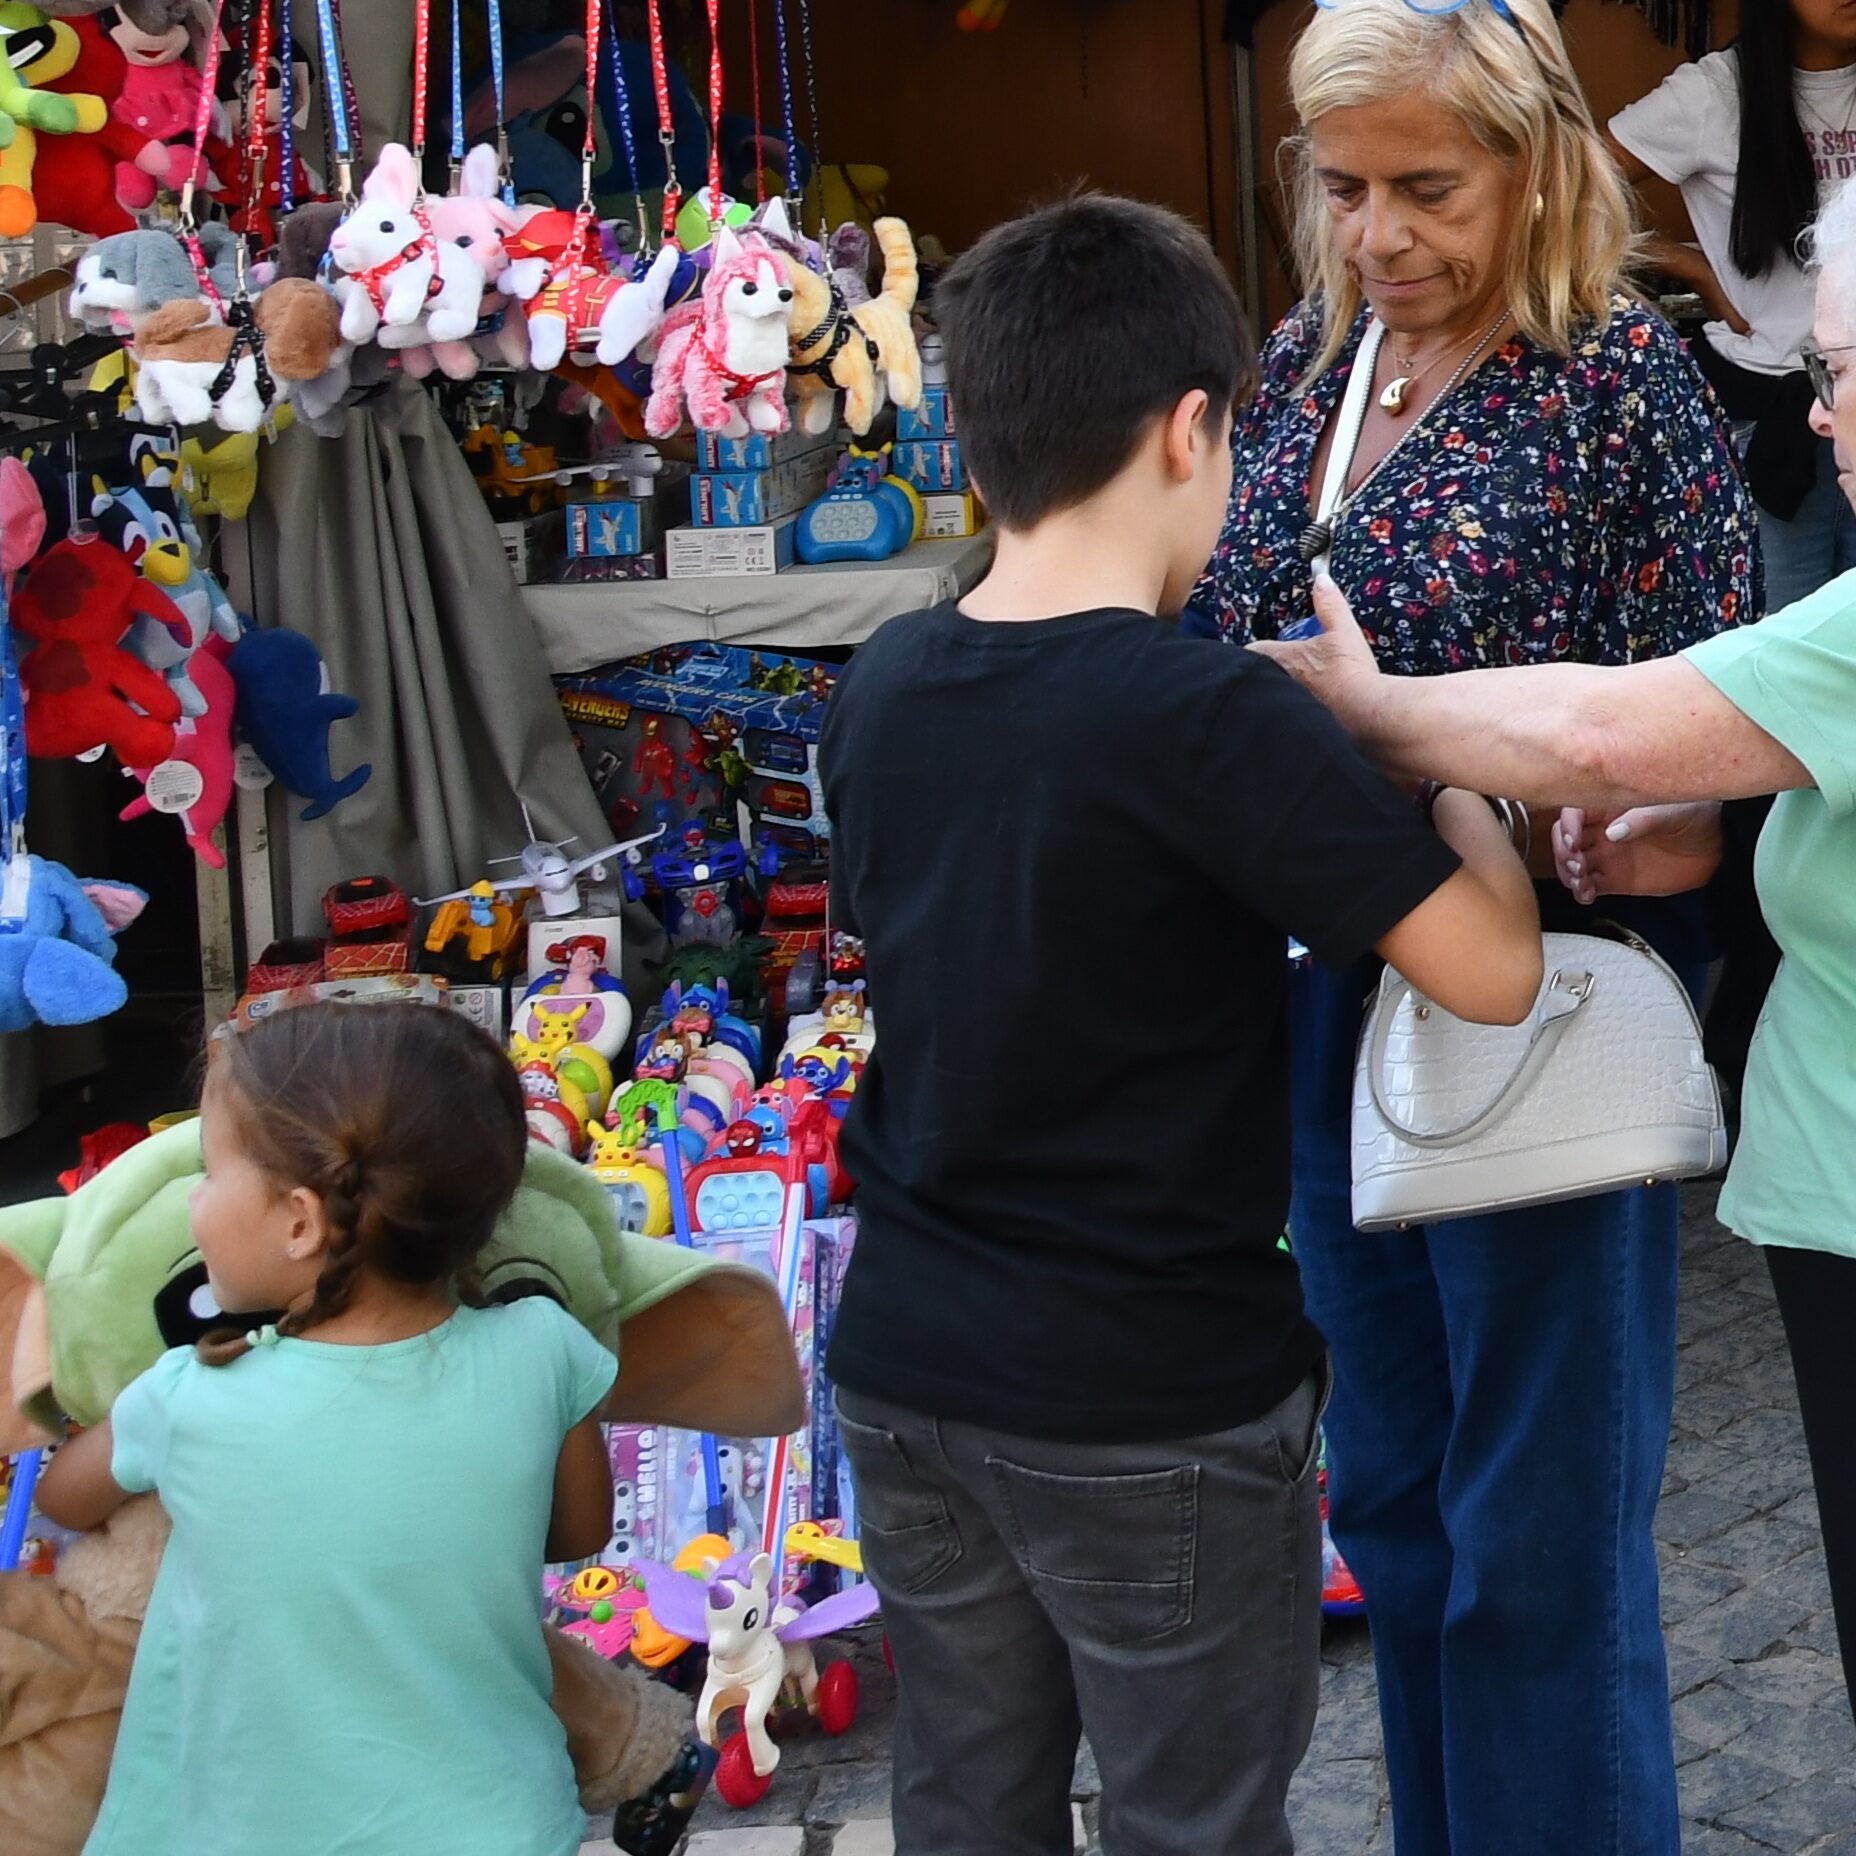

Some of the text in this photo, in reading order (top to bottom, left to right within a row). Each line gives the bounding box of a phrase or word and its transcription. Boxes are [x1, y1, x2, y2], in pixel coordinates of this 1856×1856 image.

[701, 478, 711, 522] AIRLINES
[575, 509, 586, 554] AIRLINES
[635, 678, 757, 704] AVENGERS CARS
[637, 1429, 657, 1503] HELLO
